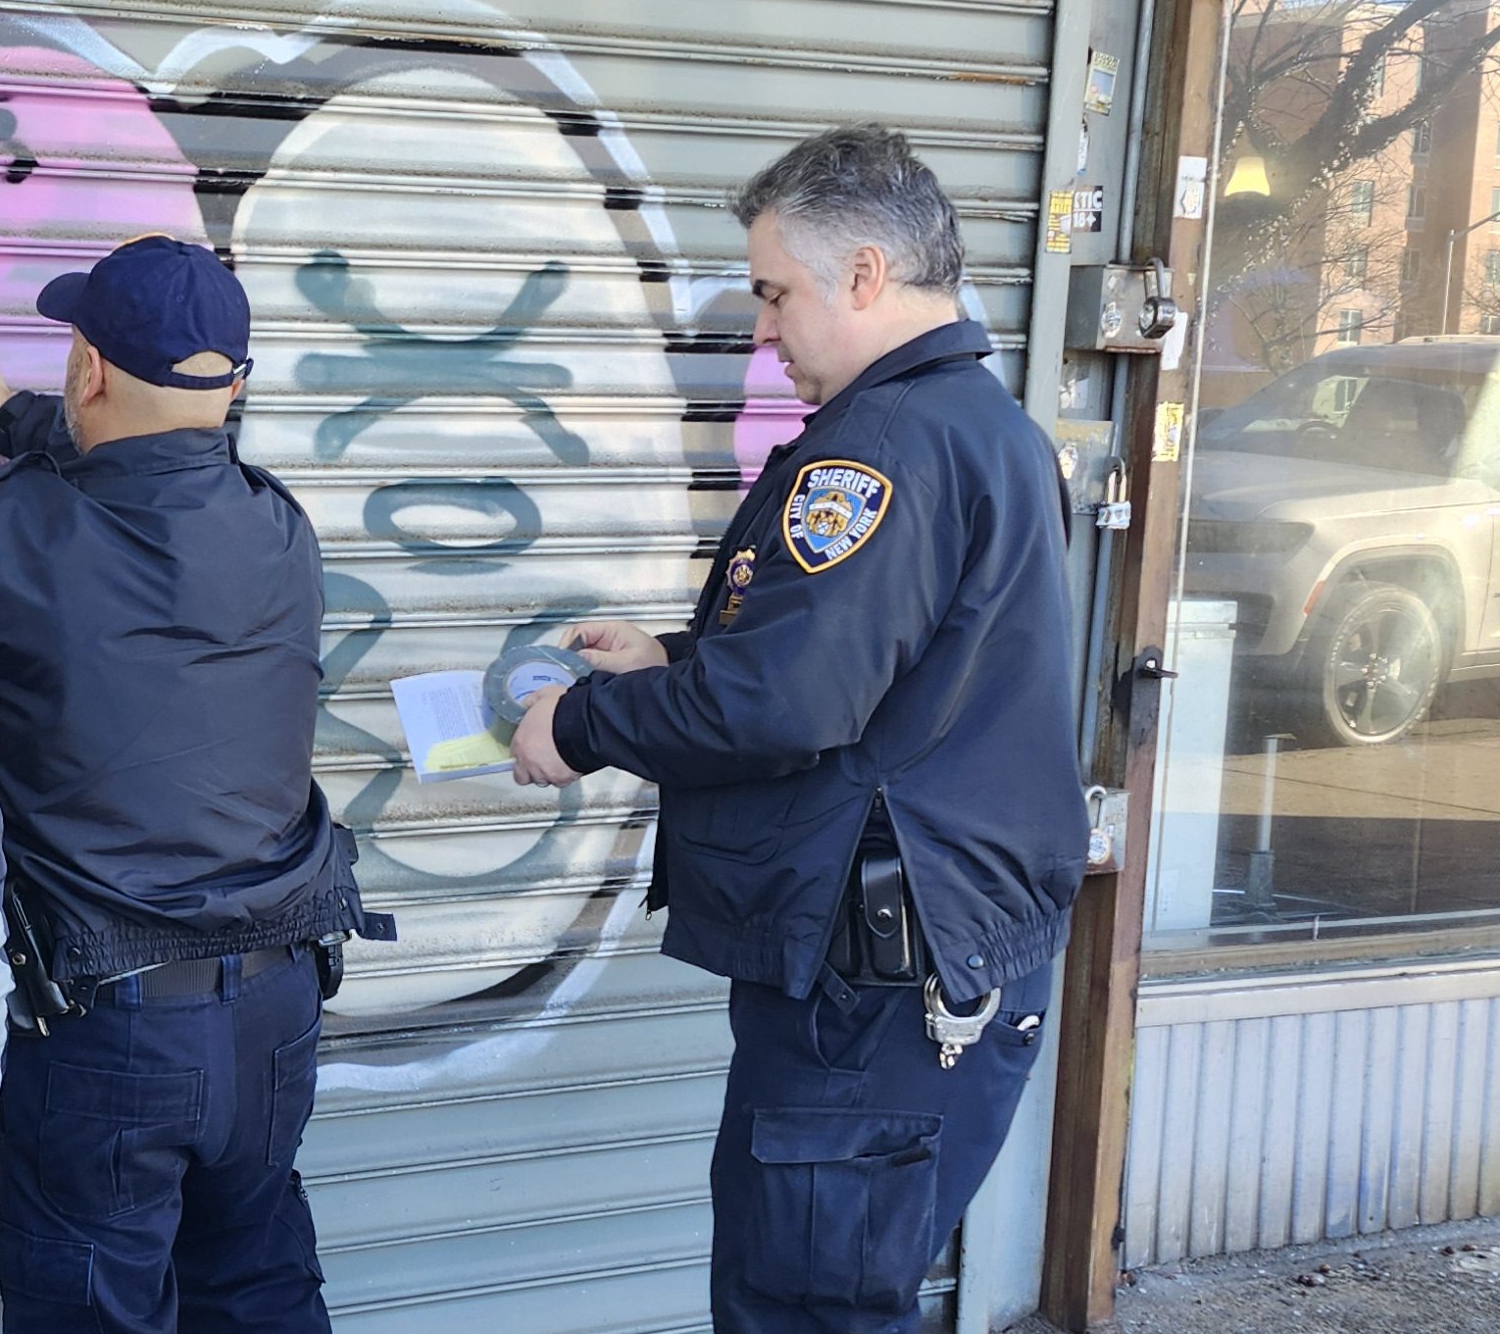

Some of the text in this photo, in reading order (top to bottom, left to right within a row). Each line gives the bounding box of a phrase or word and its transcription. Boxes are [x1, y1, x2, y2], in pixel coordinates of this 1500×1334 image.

[807, 468, 881, 499] SHERIFF
[789, 494, 806, 539] CITY OF
[824, 508, 878, 560] NEW YORK
